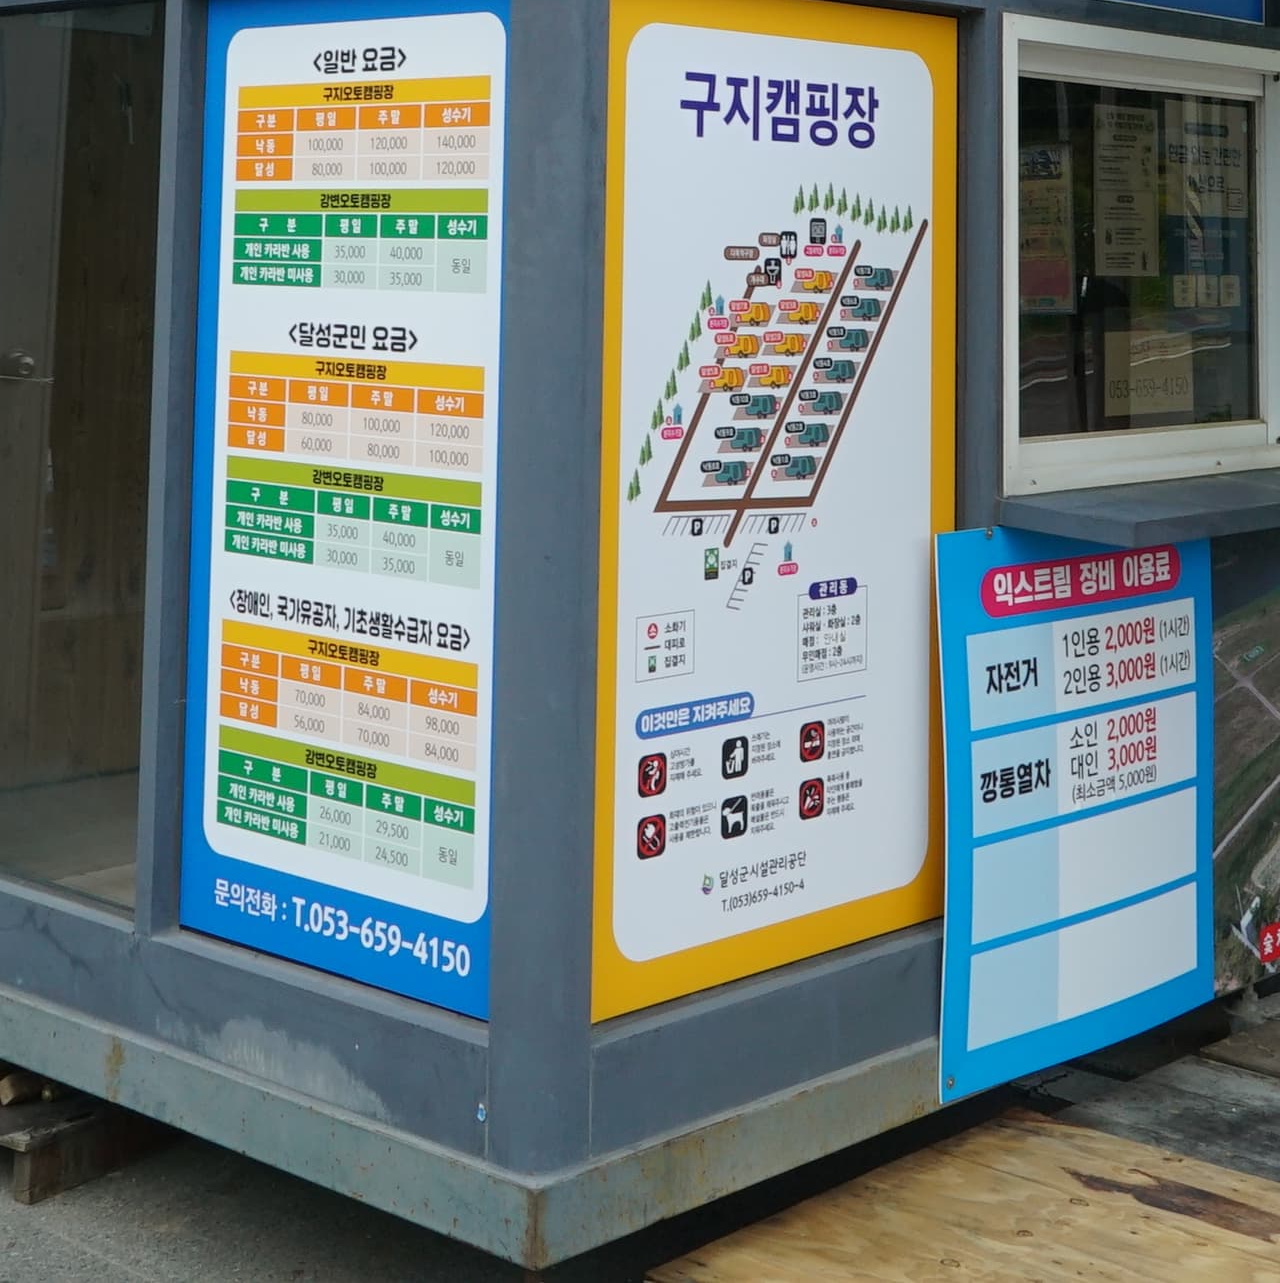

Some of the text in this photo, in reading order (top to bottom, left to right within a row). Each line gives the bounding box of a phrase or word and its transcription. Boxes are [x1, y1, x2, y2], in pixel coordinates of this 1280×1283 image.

[323, 85, 394, 101] 구지오토캠핑장
[442, 108, 471, 123] 성수기
[680, 71, 879, 148] 구지캠핑장
[308, 138, 343, 151] 100,000
[371, 137, 408, 151] 120,000
[437, 135, 476, 149] 140,000
[312, 161, 475, 176] 80,000 100,000 120,000
[320, 194, 391, 209] 강변오토캠핑장
[447, 219, 477, 236] 성수기
[335, 245, 365, 259] 35,000
[390, 246, 423, 260] 40,000
[334, 271, 365, 284] 30,000
[390, 272, 422, 286] 35,000
[316, 361, 387, 380] 구지오토캠핑장
[434, 396, 464, 412] 성수기
[302, 412, 332, 427] 80,000
[363, 418, 400, 434] 100,000
[430, 423, 469, 439] 120,000
[301, 438, 469, 466] 60,000 80,000 100,000
[312, 470, 384, 491] 강변오토캠핑장
[440, 510, 470, 528] 성수기
[328, 523, 358, 539] 35,000
[383, 530, 416, 547] 40,000
[327, 550, 358, 565] 30,000
[383, 558, 415, 574] 35,000
[994, 550, 1170, 605] 익스트림 장비 이용료
[344, 607, 432, 646] 기초생활수급자
[664, 621, 686, 633] 소화기
[1063, 614, 1189, 658] 1인용 2,000원 (1시간)
[308, 640, 379, 666] 구지오토캠핑장
[664, 638, 685, 650] 대피로
[985, 658, 1039, 695] 자전거
[1064, 650, 1191, 695] 2인용 3,000원 (1시간)
[428, 688, 457, 707] 성수기
[295, 690, 325, 707] 70,000
[358, 703, 390, 720] 84,000
[425, 717, 459, 735] 98,000
[641, 697, 751, 734] 이것만은 지켜주세요
[294, 716, 458, 762] 56,000 70,000 84,000
[1070, 707, 1156, 749] 소인 2,000원
[305, 749, 377, 779] 강변오토캠핑장
[1071, 735, 1156, 779] 대인 3,000원
[980, 758, 1051, 803] 깡통열차
[1073, 764, 1156, 804] (최소금액 5,000원)
[320, 806, 351, 825] 26,000
[376, 820, 408, 840] 29,500
[433, 806, 463, 826] 성수기
[319, 833, 350, 852] 21,000
[376, 847, 408, 866] 24,500
[215, 878, 470, 977] 문의전화 T.053-659-4150
